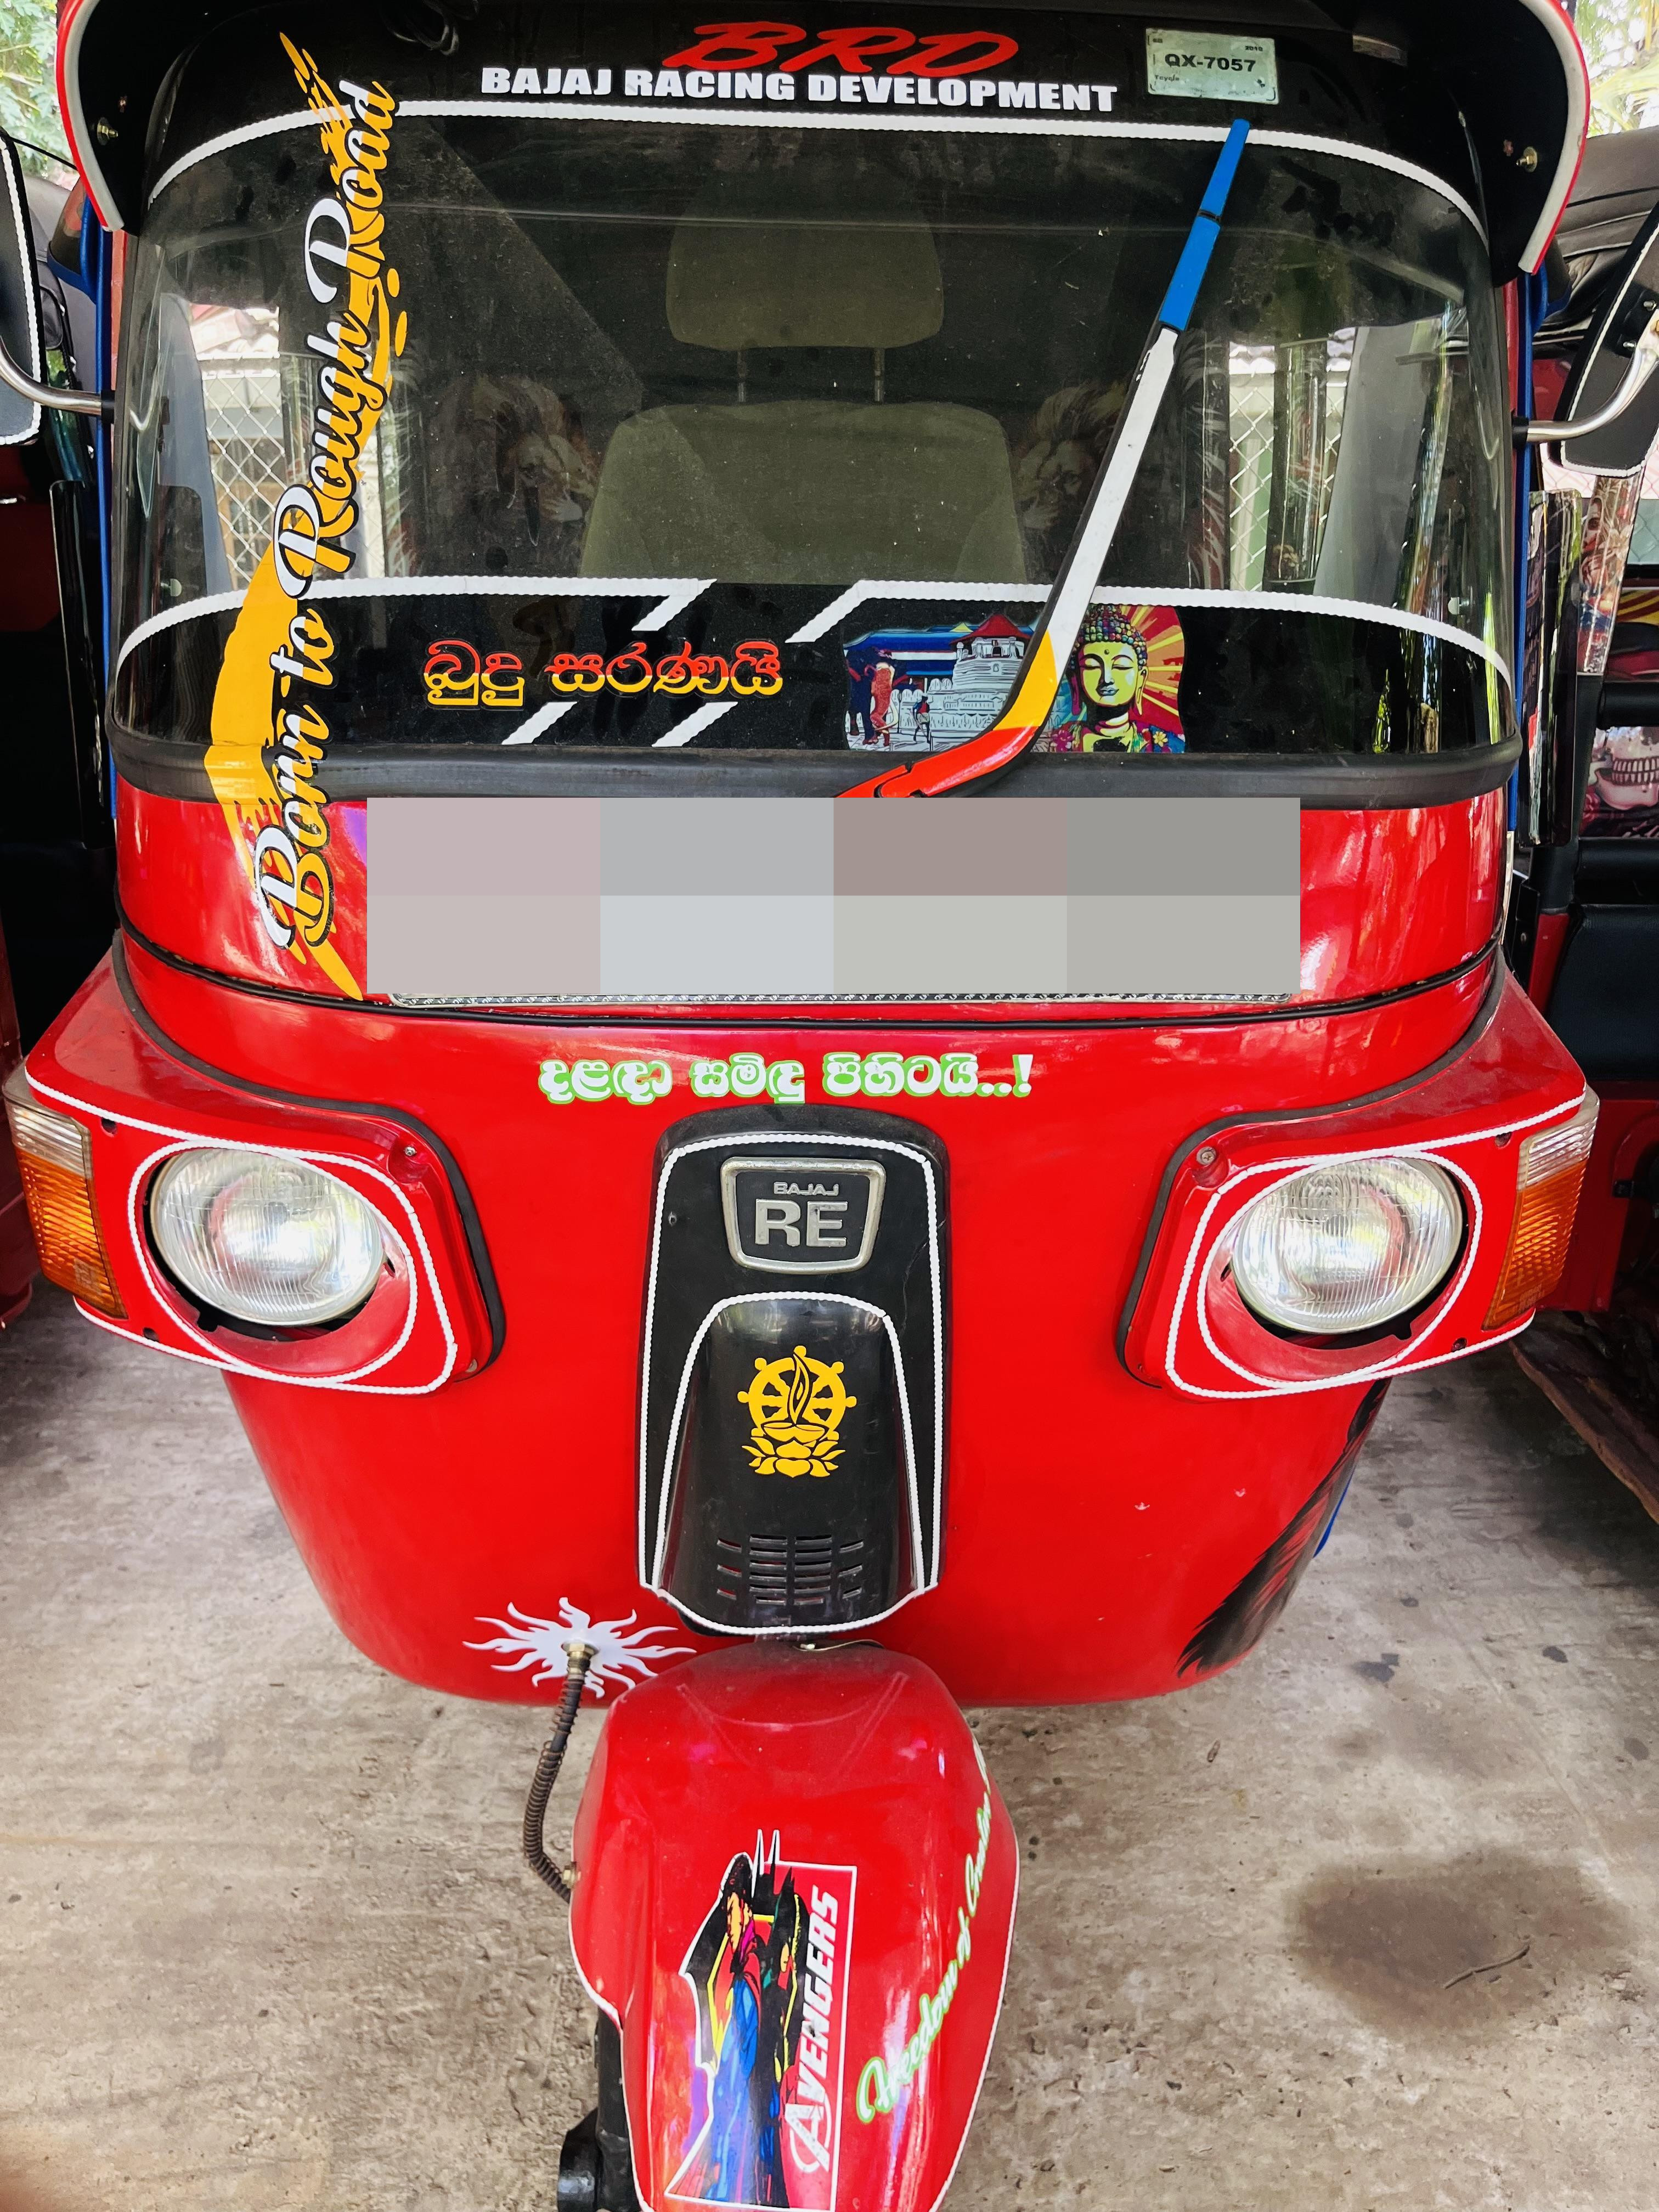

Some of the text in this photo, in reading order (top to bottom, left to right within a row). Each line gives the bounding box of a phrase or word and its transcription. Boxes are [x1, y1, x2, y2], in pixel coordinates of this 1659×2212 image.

[662, 21, 1018, 77] BRD
[1164, 53, 1256, 72] QX-7057
[481, 67, 1117, 111] BAJAJ RACING DEVELOPMENT
[253, 80, 396, 950] Born to Rough Road
[424, 639, 783, 707] බුදු සරණයි
[773, 1182, 839, 1196] BAJAJ
[755, 1198, 848, 1247] RE
[856, 1959, 958, 2123] Freedom
